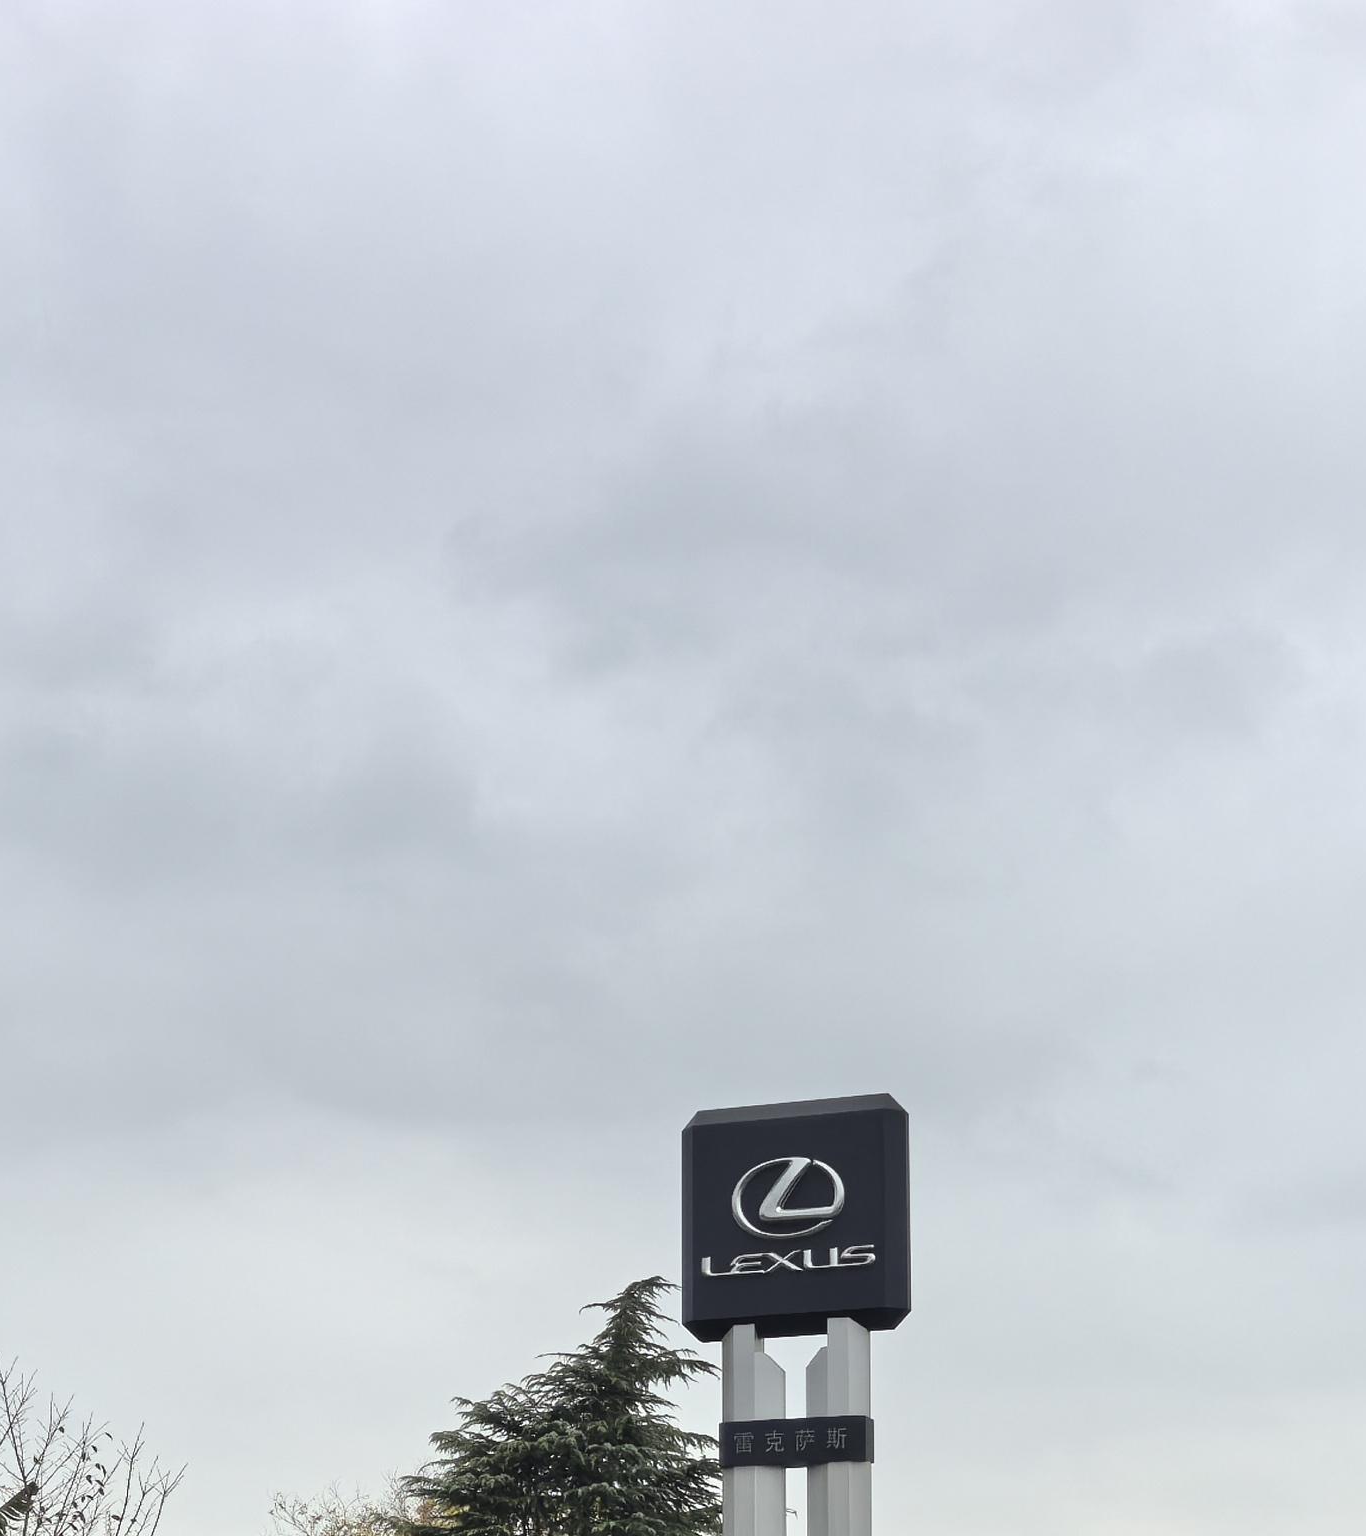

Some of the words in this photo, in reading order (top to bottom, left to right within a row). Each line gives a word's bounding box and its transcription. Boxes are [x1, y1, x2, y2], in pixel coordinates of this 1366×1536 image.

[701, 1244, 876, 1278] LEXUS
[733, 1427, 848, 1454] 雷克萨斯
